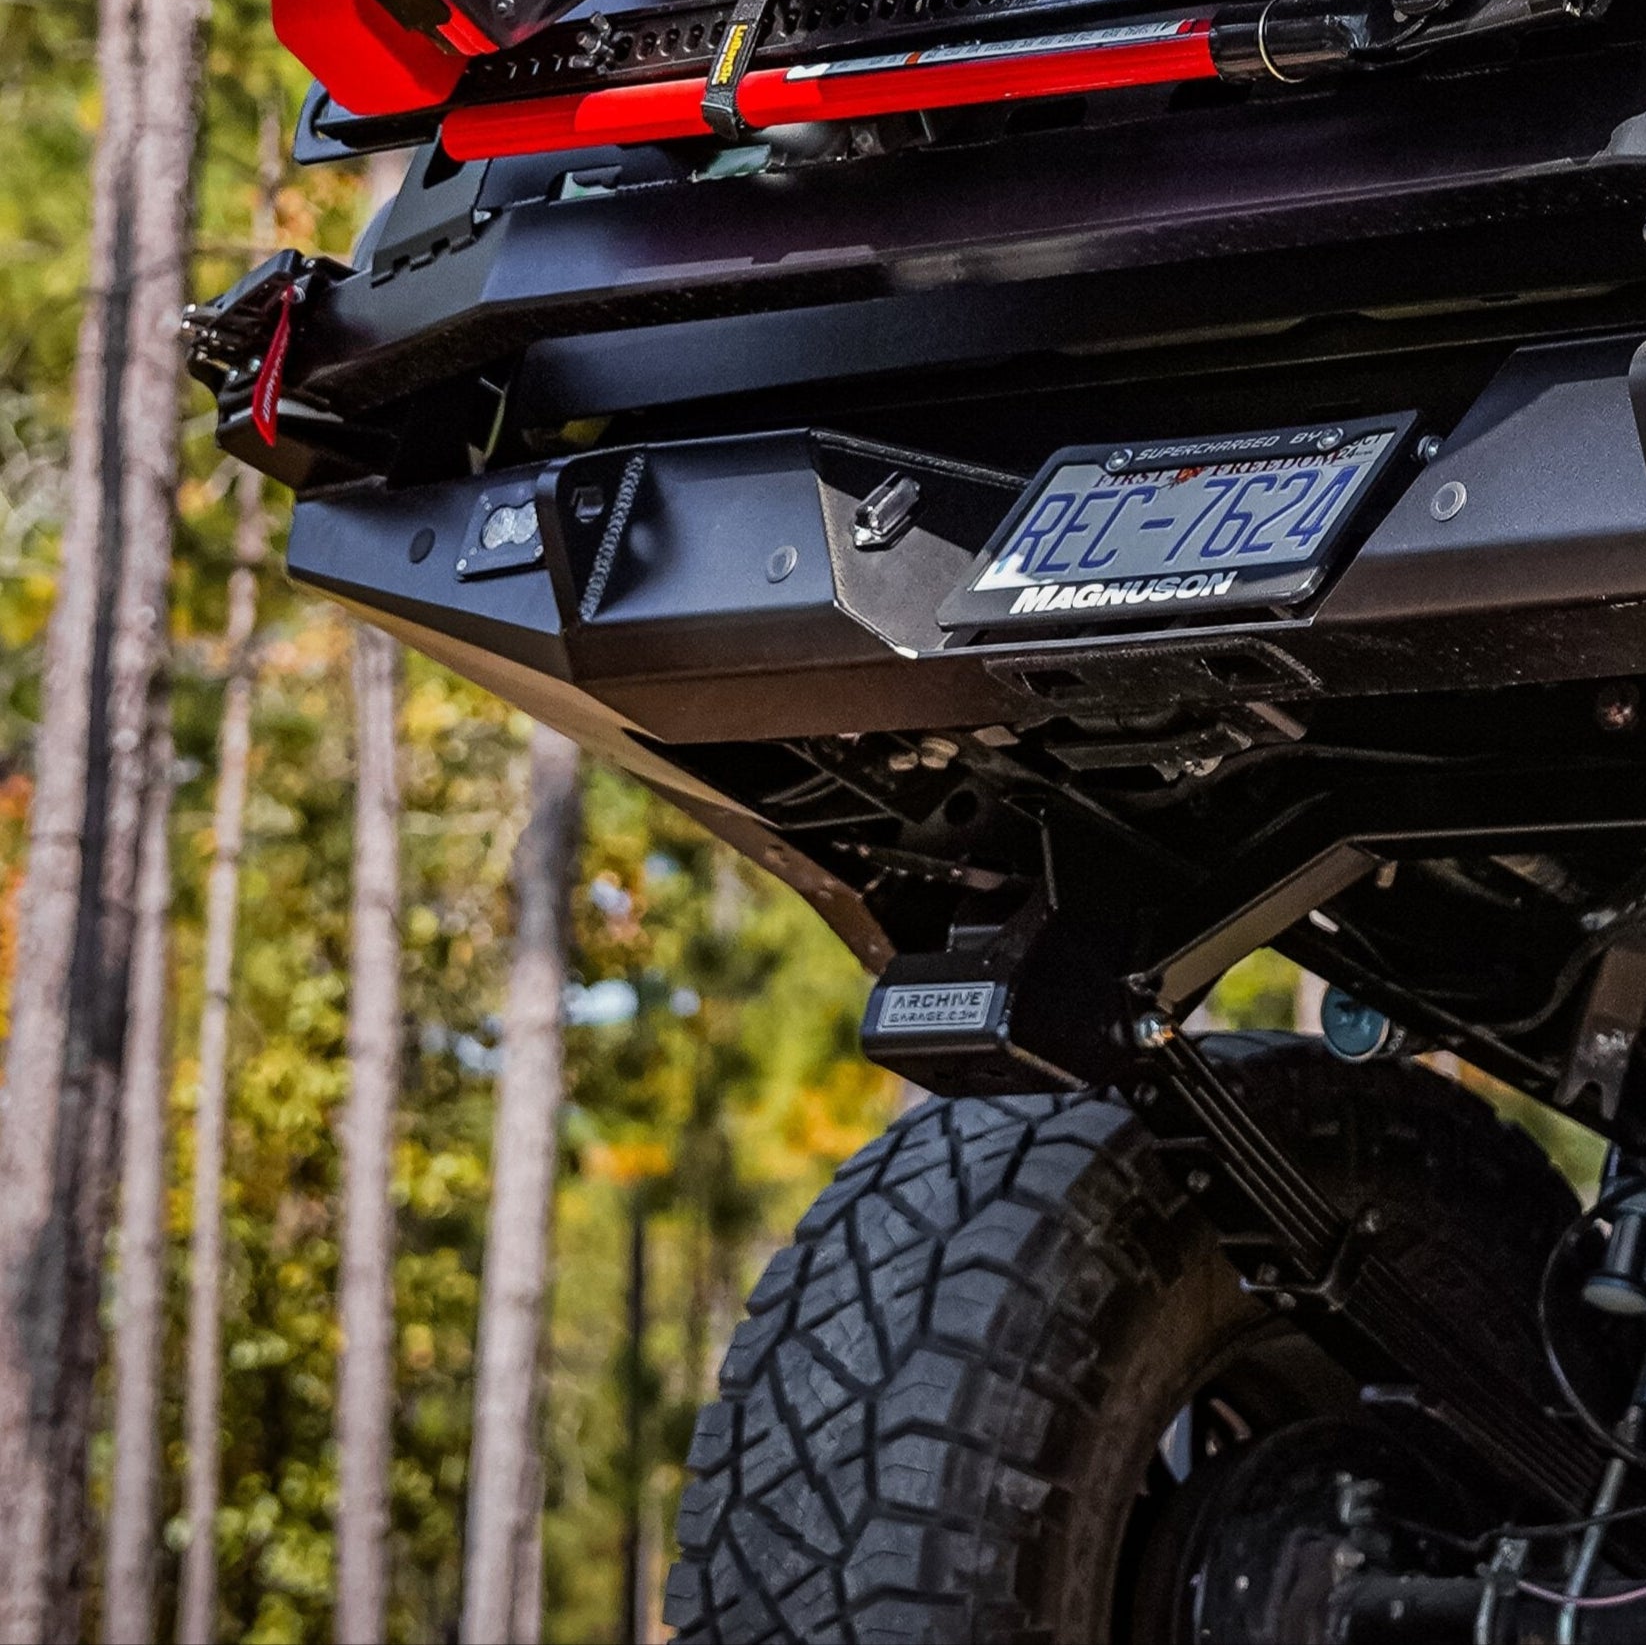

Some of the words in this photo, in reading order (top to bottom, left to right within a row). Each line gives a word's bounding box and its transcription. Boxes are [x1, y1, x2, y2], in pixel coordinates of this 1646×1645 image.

[1134, 435, 1281, 462] SUPERCHARGED
[1288, 430, 1323, 445] BY
[1092, 471, 1164, 489] FIRST
[995, 466, 1358, 574] REC-7624
[1009, 571, 1238, 615] MAGNUSON
[893, 991, 984, 1009] ARCHIVE
